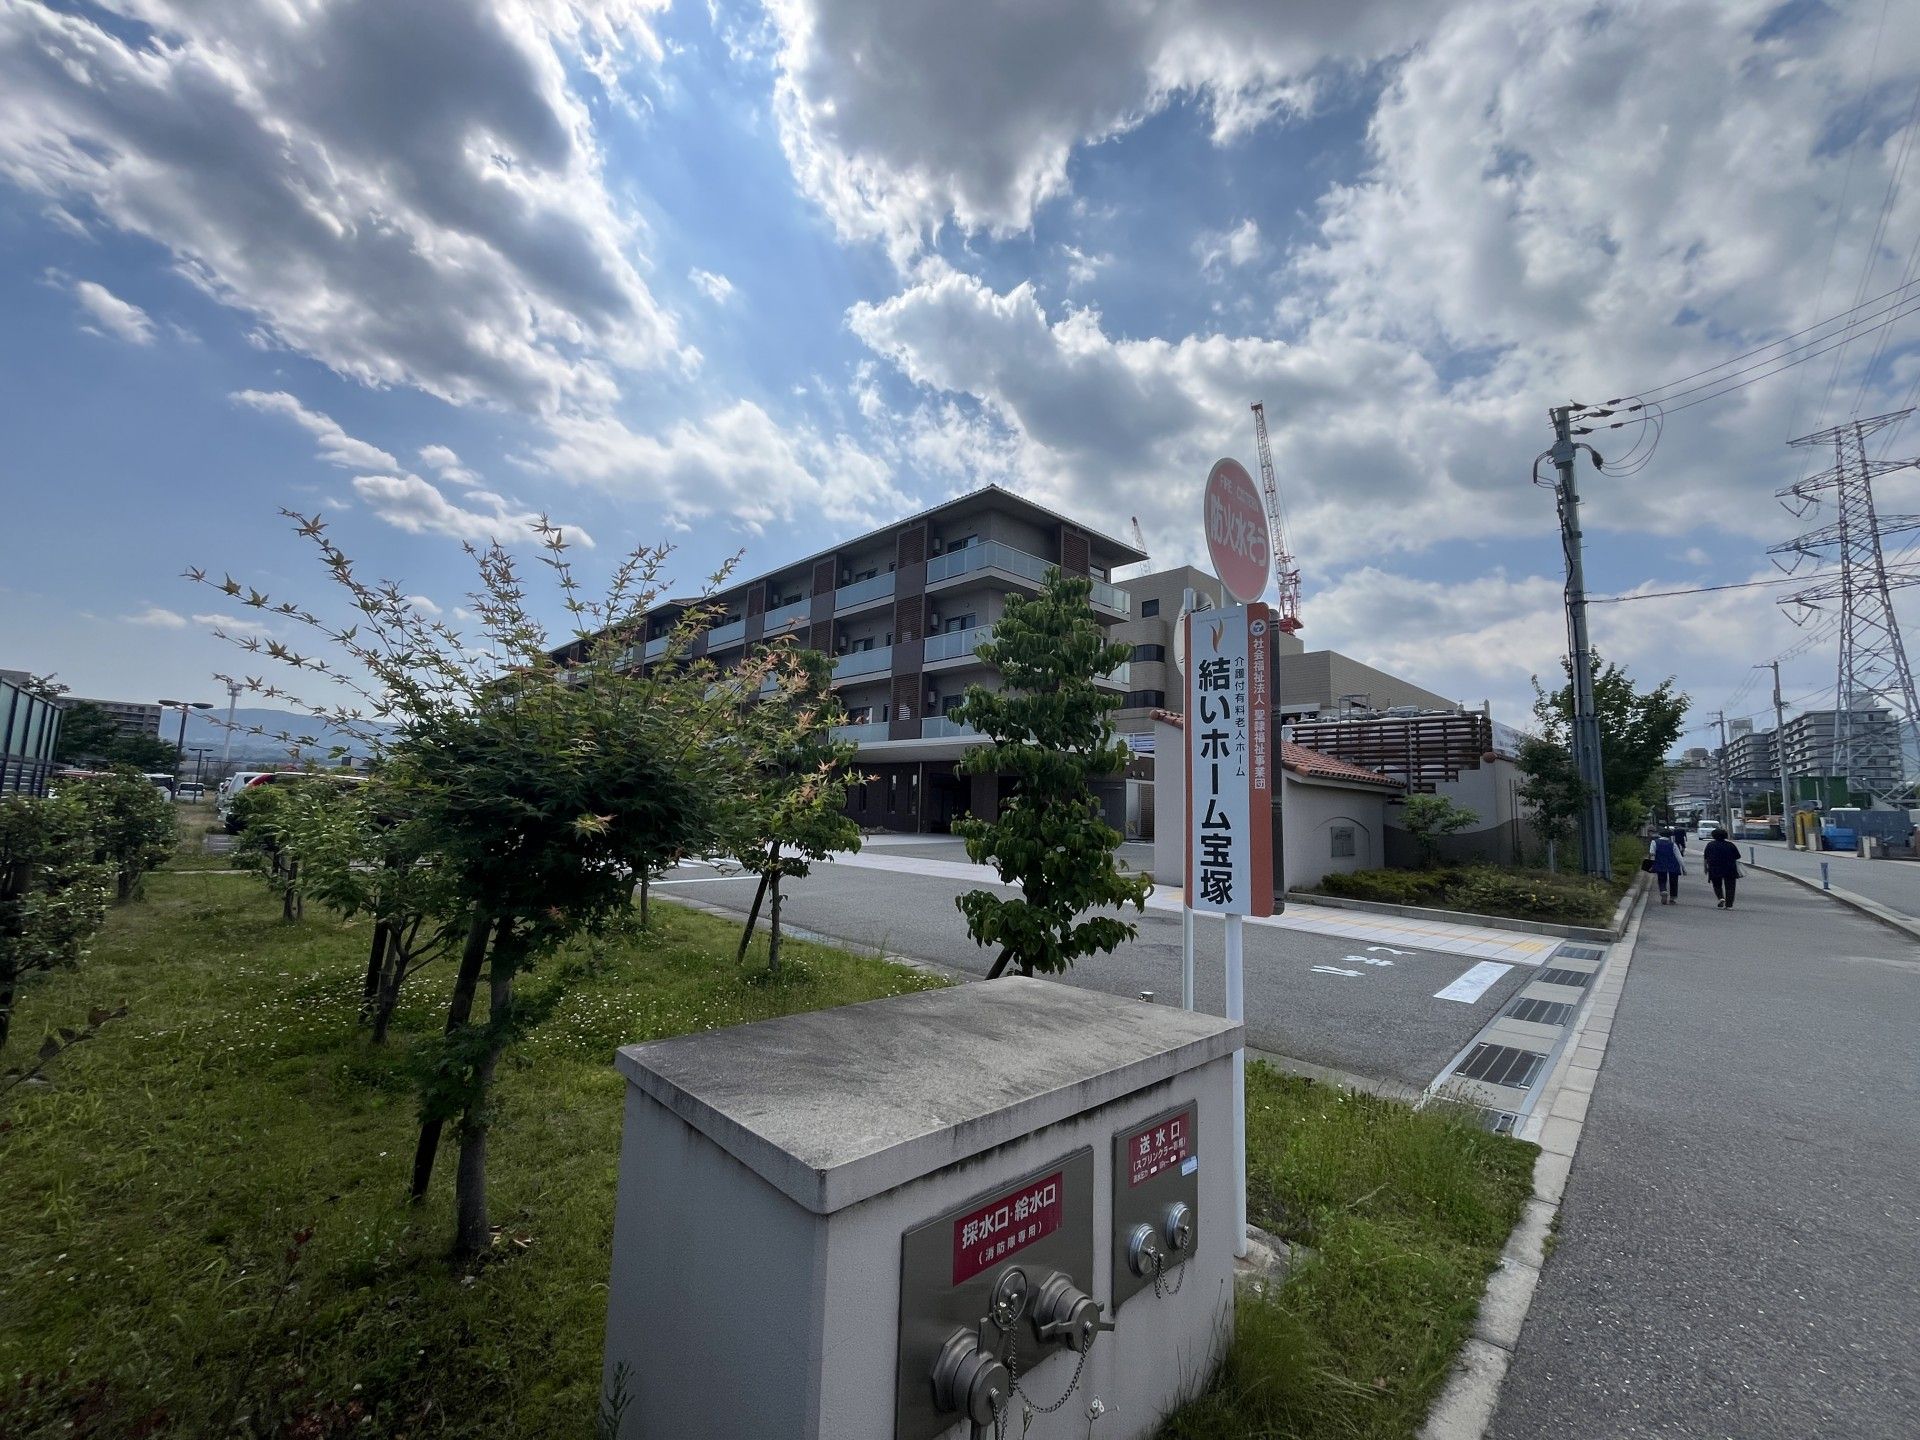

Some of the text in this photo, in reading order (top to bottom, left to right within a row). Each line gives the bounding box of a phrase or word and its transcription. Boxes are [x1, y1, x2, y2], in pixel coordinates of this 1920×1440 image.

[1198, 656, 1233, 905] 結いホーム宝塚
[1234, 656, 1246, 777] 介護付有料老人ホーム
